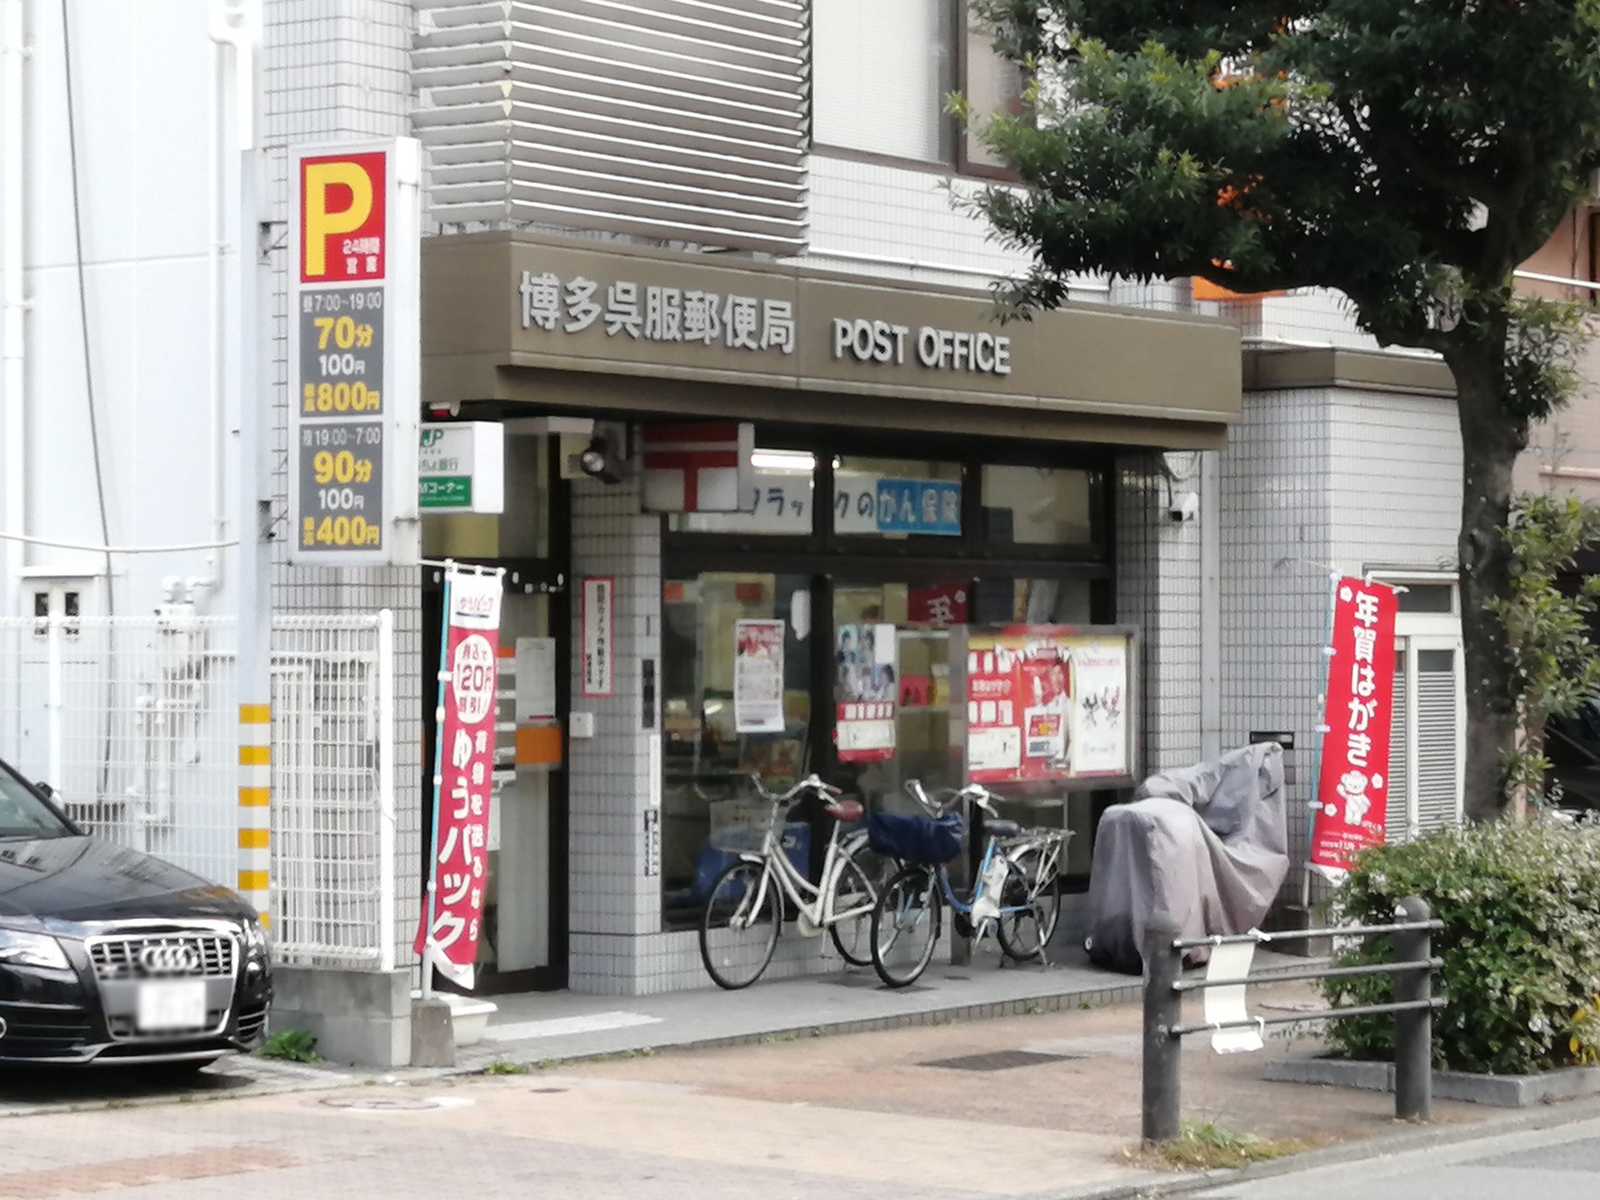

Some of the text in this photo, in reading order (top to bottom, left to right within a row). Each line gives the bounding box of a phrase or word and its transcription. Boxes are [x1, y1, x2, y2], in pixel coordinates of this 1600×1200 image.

[305, 161, 373, 276] P
[313, 315, 374, 350] 70分
[519, 270, 795, 353] 博多呉服郵便局
[319, 354, 366, 376] 100円
[833, 318, 1012, 374] POST OFFICE
[314, 451, 373, 484] 90分
[318, 488, 365, 510] 100円
[1347, 590, 1379, 768] 年賀はがき
